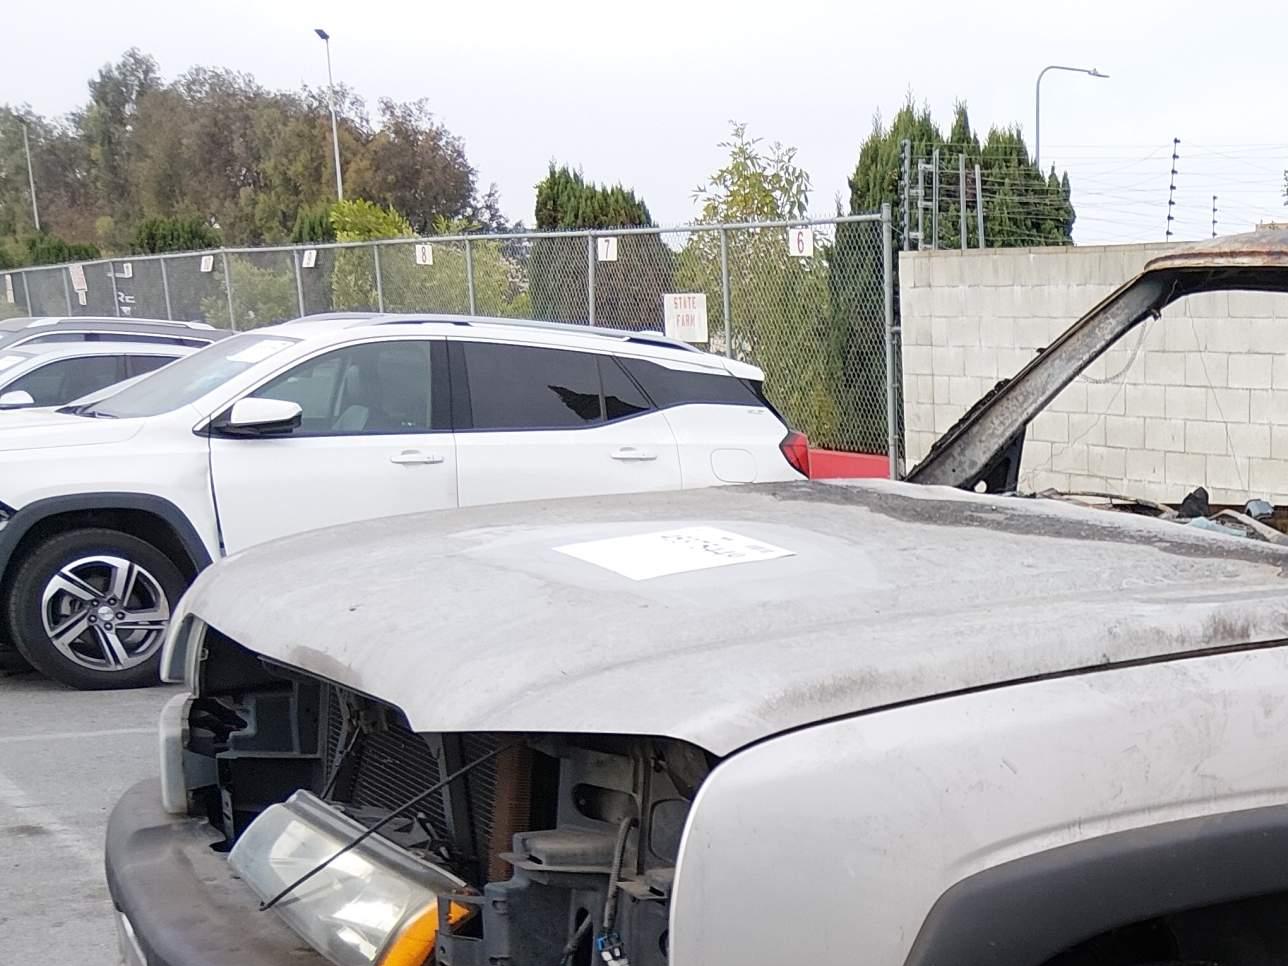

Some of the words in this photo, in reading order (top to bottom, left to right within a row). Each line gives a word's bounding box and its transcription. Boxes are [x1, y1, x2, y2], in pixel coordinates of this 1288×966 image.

[603, 239, 611, 260] 7
[796, 231, 805, 254] 6
[421, 246, 427, 264] 8
[673, 296, 697, 310] STATE
[676, 314, 696, 329] FARM
